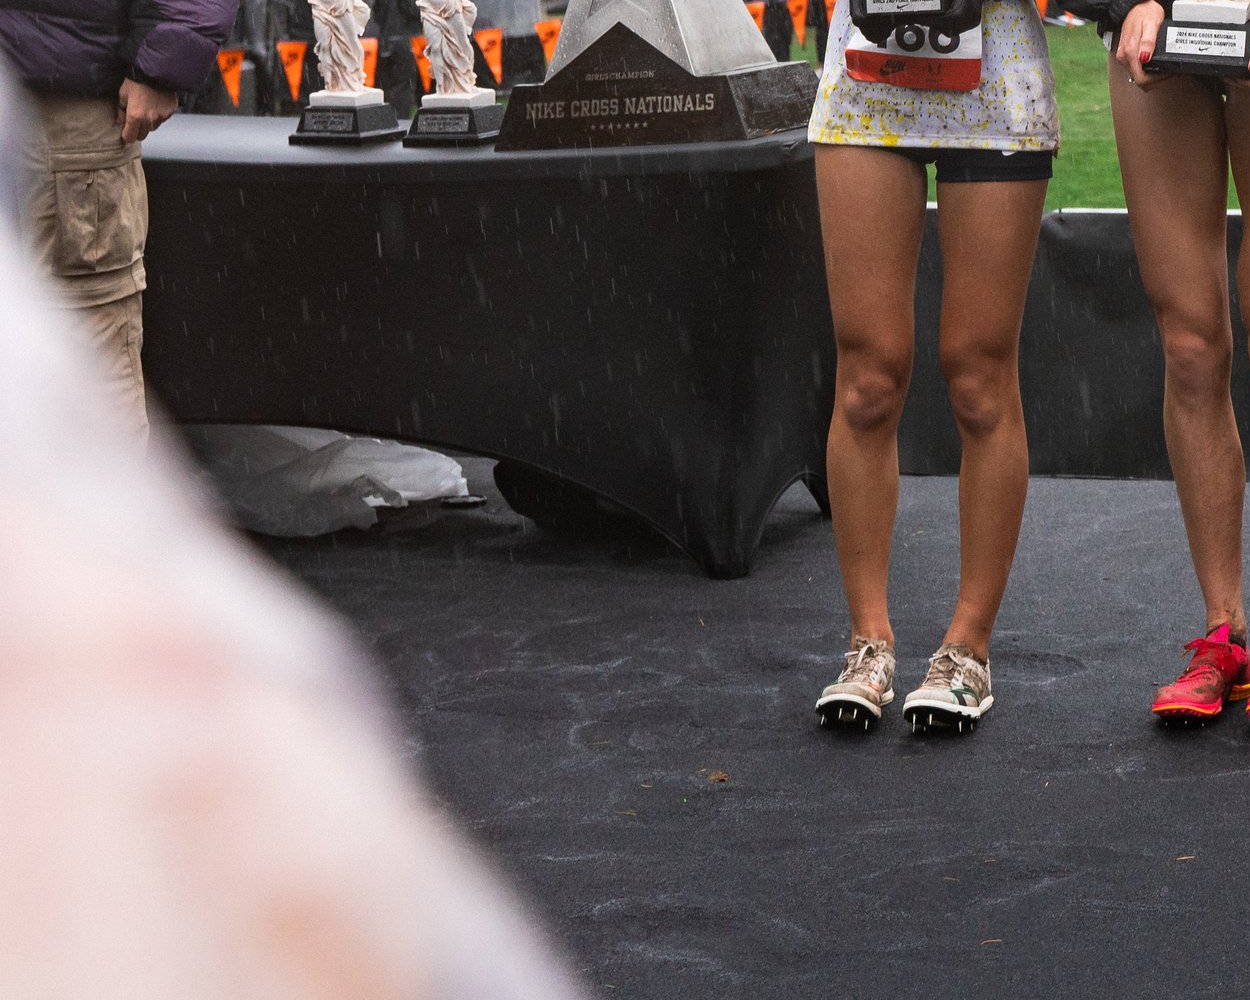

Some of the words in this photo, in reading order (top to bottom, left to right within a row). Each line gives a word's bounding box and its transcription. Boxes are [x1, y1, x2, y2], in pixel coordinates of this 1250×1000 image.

[609, 69, 656, 80] CHAMPION
[526, 101, 565, 120] NIKE
[570, 98, 619, 118] CROSS
[624, 93, 715, 115] NATIONALS
